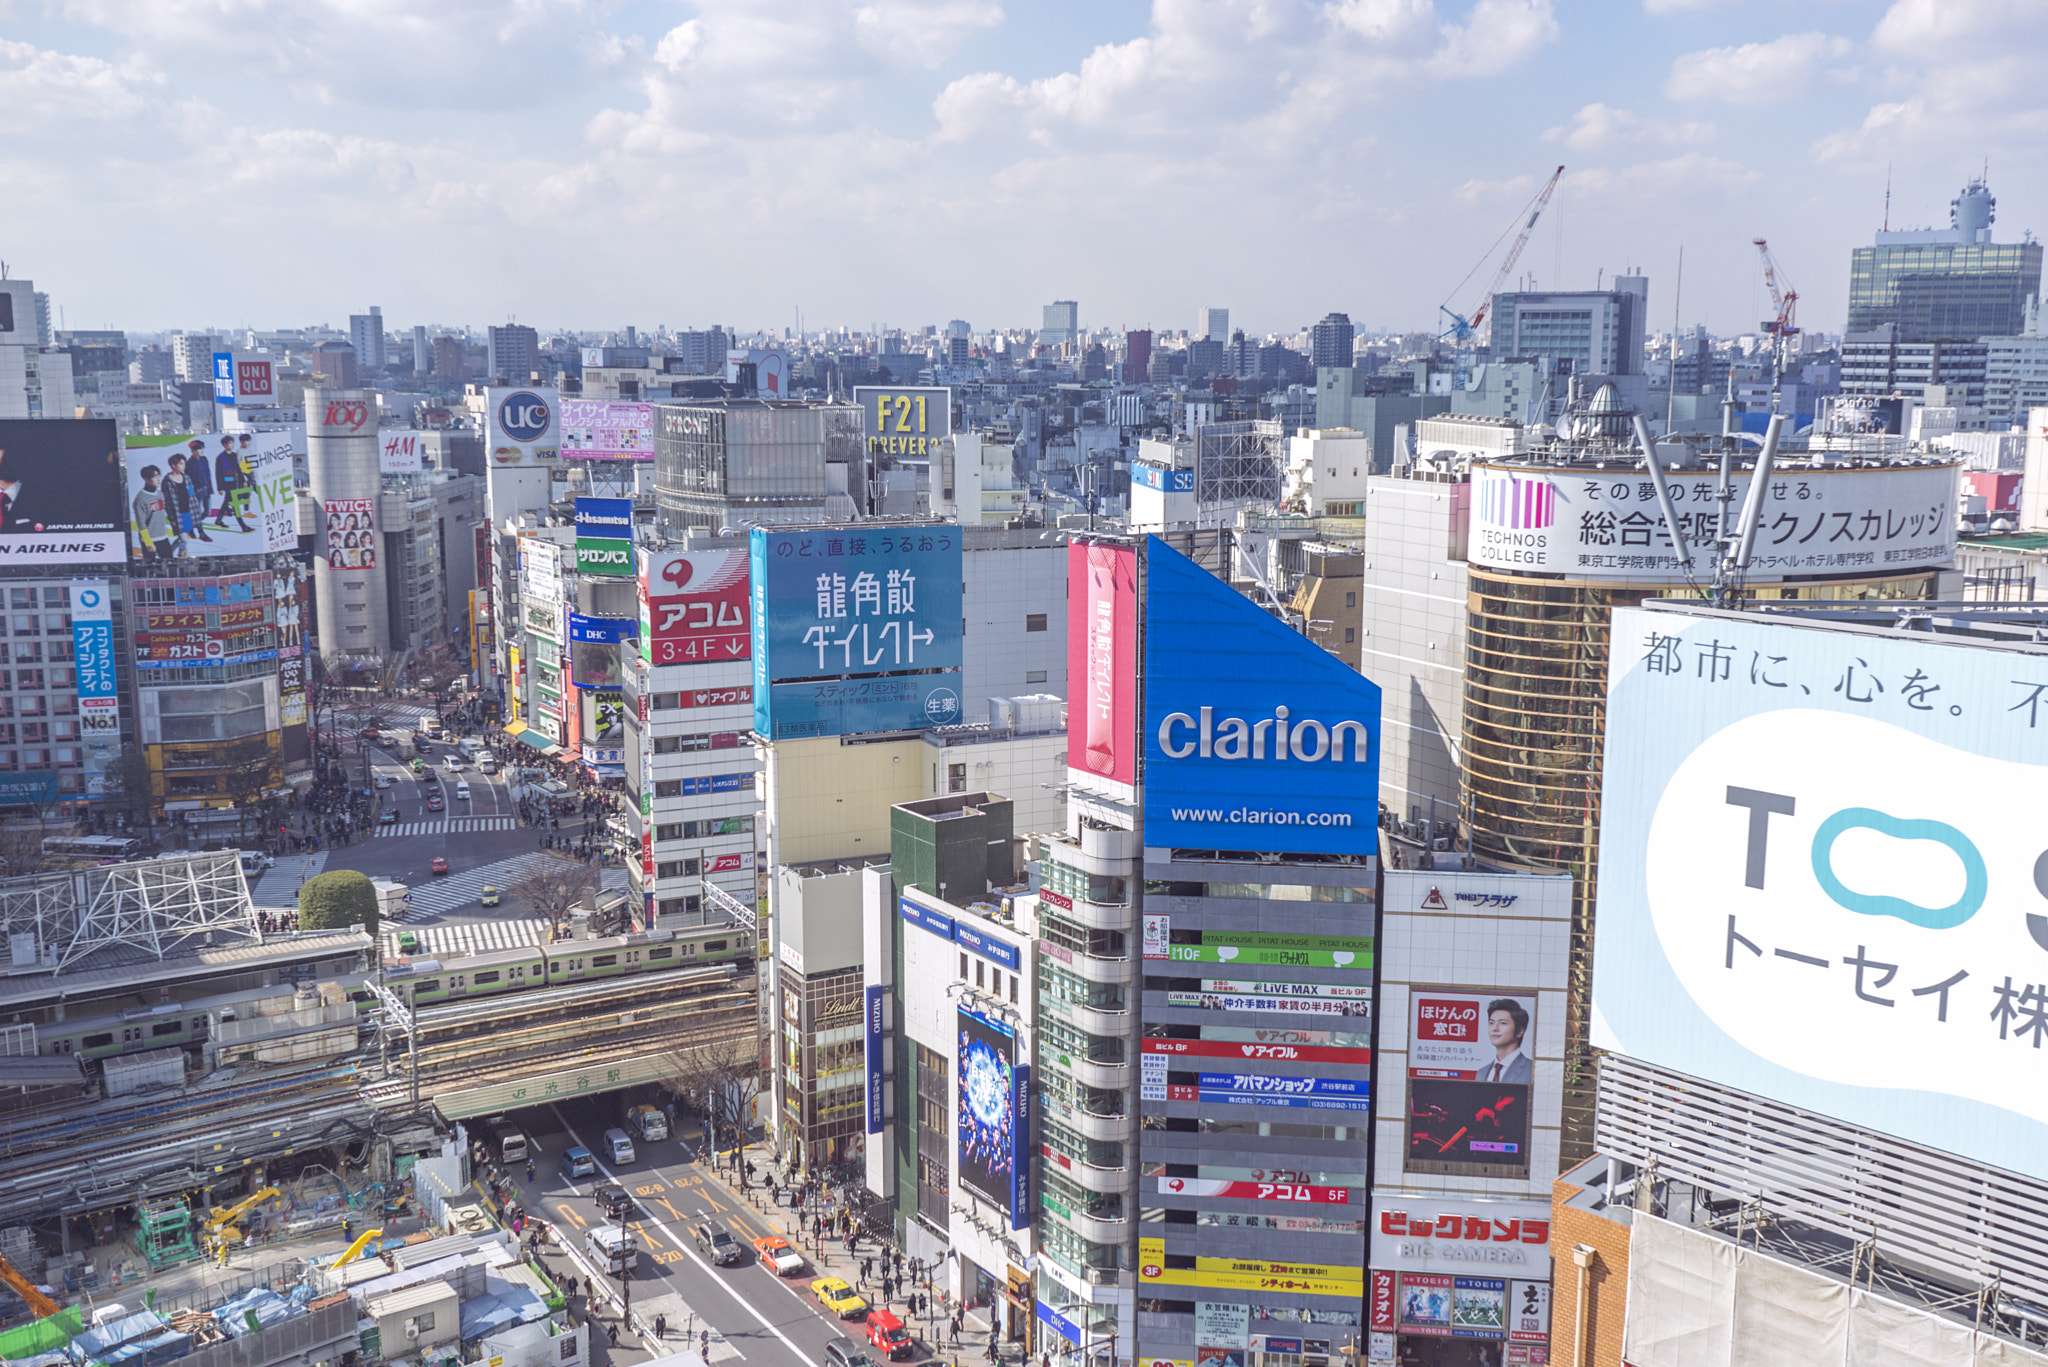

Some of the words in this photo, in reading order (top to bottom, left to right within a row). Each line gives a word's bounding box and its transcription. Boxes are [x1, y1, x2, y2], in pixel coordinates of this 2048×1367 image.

[242, 365, 266, 378] UNI
[242, 380, 268, 394] QLO
[560, 403, 610, 418] サイサイ
[878, 394, 926, 433] F21
[322, 406, 368, 432] 109
[560, 417, 645, 428] セレクションアルバム
[384, 436, 416, 457] H&M
[868, 436, 926, 454] OREVER
[230, 474, 294, 518] FIVE
[326, 500, 372, 512] TWICE
[266, 510, 284, 526] 2017
[577, 512, 629, 526] Hisamitsu
[267, 520, 293, 541] 2.22
[270, 540, 280, 550] ON
[280, 534, 294, 547] SALE
[777, 535, 952, 558] のど、直接、うるおう
[1482, 530, 1547, 548] TECHNOS
[16, 542, 106, 554] AIRLINES
[1481, 546, 1547, 565] COLLEGE
[578, 548, 628, 565] サロンパス
[816, 568, 916, 619] 龍角散
[150, 614, 204, 626] プライス
[220, 608, 262, 624] コンタクト
[658, 600, 744, 632] アコム
[186, 634, 212, 642] ガスト
[252, 625, 272, 636] ガスト
[586, 630, 606, 640] DHC
[137, 648, 150, 656] 7F
[170, 645, 203, 658] ガスト
[802, 620, 934, 670] ダイレクト
[77, 627, 96, 692] アイシティ
[98, 627, 112, 692] コンタクトの
[1096, 600, 1112, 720] 龍角散ダイレクト
[1641, 631, 1962, 716] 都市に、心を。
[710, 690, 750, 703] アイフル
[814, 683, 870, 698] スティック
[874, 682, 896, 693] ミント
[596, 703, 618, 714] FX
[928, 697, 956, 714] 生薬
[82, 714, 118, 730] No.1
[1171, 808, 1352, 827] www.clarion.com
[718, 859, 740, 868] アコム
[744, 856, 754, 864] 4F
[1454, 893, 1518, 908] TOEIプラザ
[902, 903, 920, 918] MIZUHO
[960, 928, 980, 946] MIZUHO
[1160, 917, 1168, 954] お部屋探しは
[1203, 935, 1223, 943] PITAT
[1226, 936, 1253, 944] HOUSE
[1280, 938, 1310, 946] HOUSE
[1320, 940, 1340, 948] PITAT
[1342, 941, 1370, 949] HOUSE
[1177, 947, 1200, 960] 10F
[1280, 951, 1310, 966] ピタットハウス
[1292, 984, 1318, 995] MAX
[1330, 988, 1352, 996] 当ビル
[1354, 988, 1367, 996] 9F
[822, 996, 861, 1014] Lindt
[1224, 998, 1277, 1010] 仲介手数料
[1278, 1000, 1344, 1013] 家賃の半月分
[1421, 1006, 1476, 1020] ほけんの
[1269, 1030, 1311, 1043] アイフル
[1255, 1045, 1298, 1059] アイフル
[1417, 1045, 1473, 1054] あなたに寄り添う
[1416, 1054, 1481, 1062] 保険選びのパートナー
[512, 1088, 526, 1099] JR
[544, 1068, 620, 1096] 渋谷駅
[1234, 1075, 1315, 1092] アパマンショップ
[1321, 1082, 1355, 1091] 渋谷駅前店
[1020, 1080, 1028, 1118] MIZUHO
[1255, 1098, 1290, 1106] アップル東京
[1312, 1101, 1367, 1110] (03)6892-1515
[1269, 1170, 1311, 1184] アコム
[1258, 1184, 1311, 1201] アコム
[1328, 1190, 1346, 1201] 5F
[1208, 1213, 1278, 1228] 衣笠眼科
[1381, 1210, 1550, 1244] ビックカメラ
[652, 1250, 684, 1264] 8-20
[1400, 1242, 1434, 1258] BIC
[1440, 1244, 1527, 1265] CAMERA
[1146, 1266, 1159, 1276] 3F
[1232, 1263, 1267, 1271] お部屋探し
[1261, 1278, 1310, 1290] シティホーム
[1469, 1280, 1494, 1288] TOEI
[1376, 1275, 1390, 1324] カラオケ
[1522, 1284, 1539, 1315] えん
[1205, 1304, 1239, 1312] 衣笠眼科
[1051, 1315, 1065, 1331] DHC
[1454, 1308, 1502, 1328] キセキ
